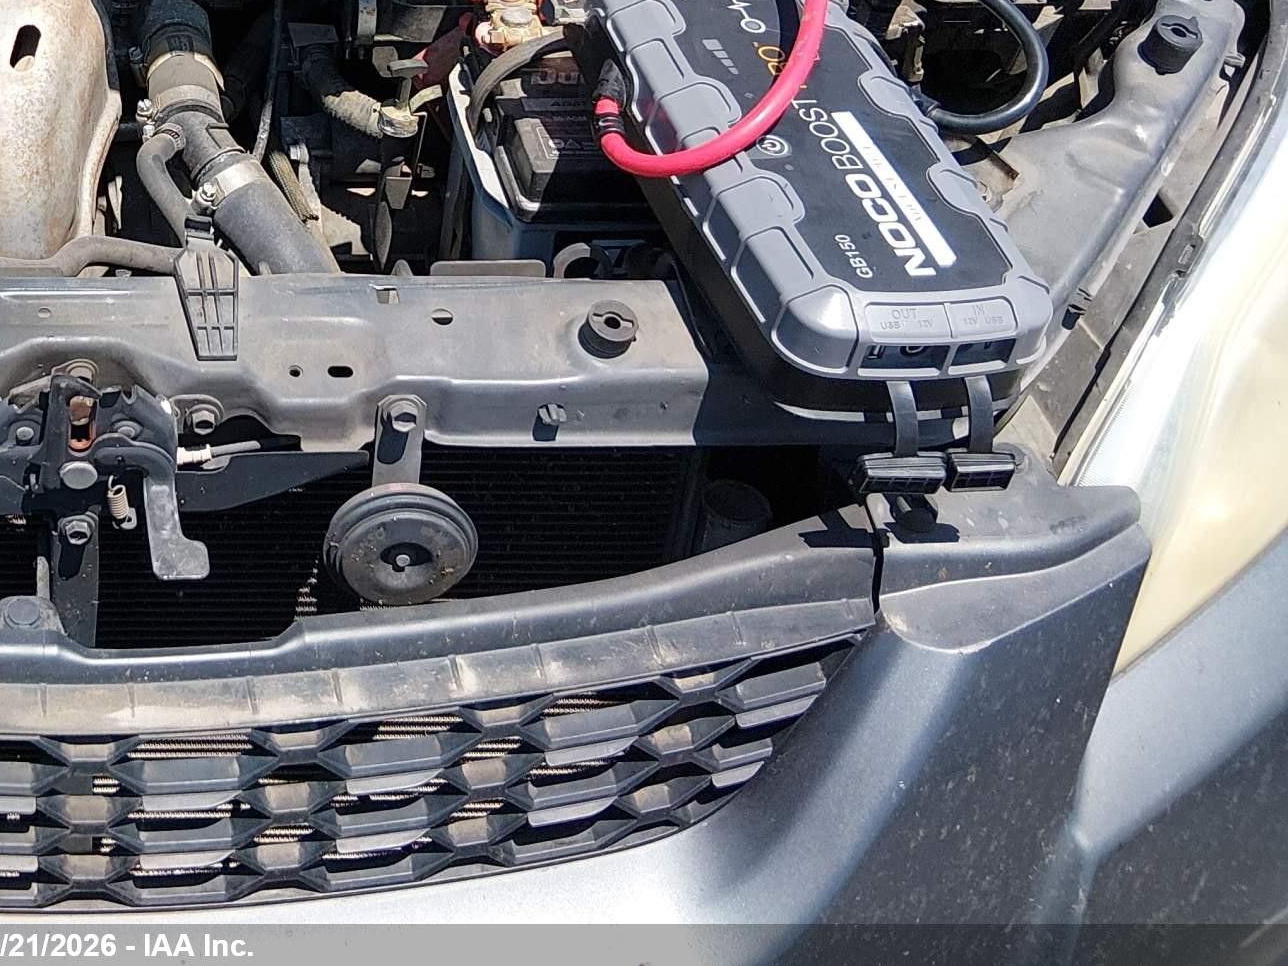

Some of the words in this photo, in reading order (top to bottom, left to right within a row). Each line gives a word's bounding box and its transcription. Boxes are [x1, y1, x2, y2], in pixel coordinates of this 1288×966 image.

[790, 98, 864, 170] BOOST
[845, 173, 937, 276] NOCO
[834, 234, 874, 278] GB150
[891, 308, 917, 321] OUT
[972, 305, 985, 315] IN
